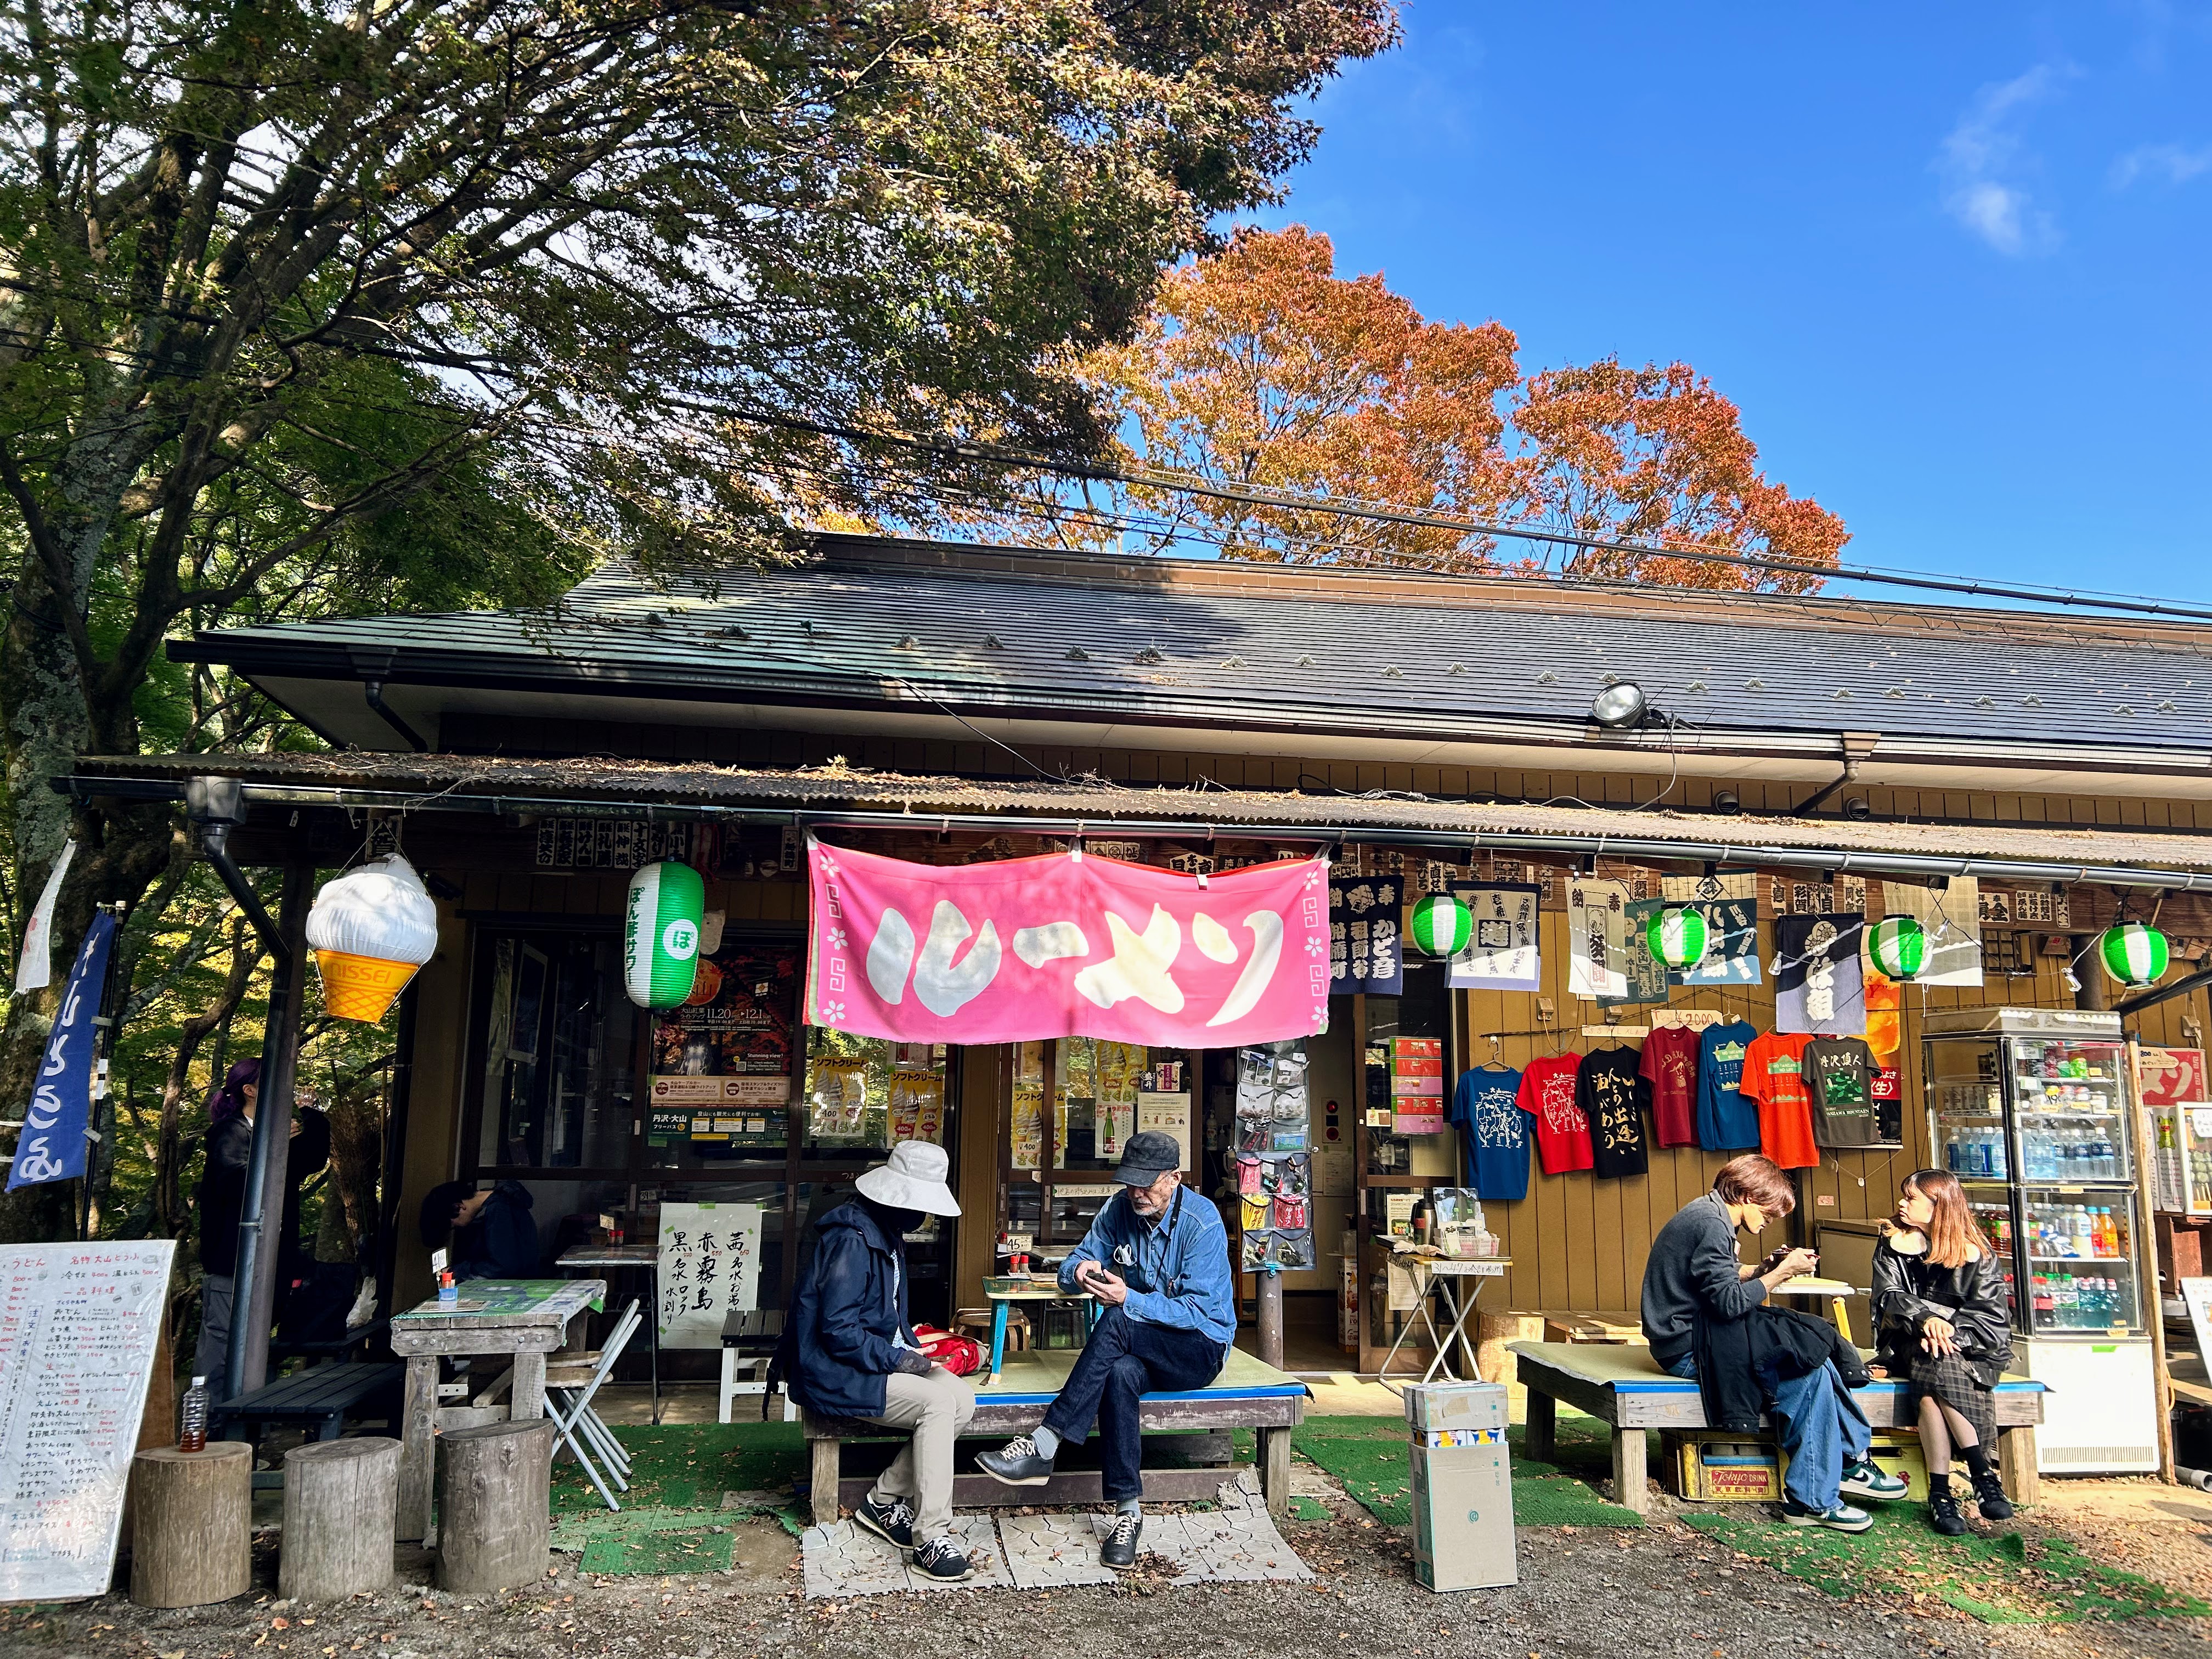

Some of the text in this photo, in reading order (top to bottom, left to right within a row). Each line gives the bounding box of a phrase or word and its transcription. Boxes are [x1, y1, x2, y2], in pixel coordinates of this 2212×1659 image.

[1329, 887, 1343, 907] 納
[1378, 884, 1395, 906] 奉
[1572, 888, 1584, 909] 納
[1609, 892, 1621, 913] 奉
[1795, 885, 1808, 912] 彩賀
[626, 887, 645, 985] ぽん酢サワー
[673, 930, 695, 950] ぽ
[1330, 922, 1348, 980] 船橋町
[1373, 919, 1396, 979] かど彦
[331, 963, 392, 984] NISSEI
[707, 1008, 731, 1019] 11.20
[1677, 1012, 1714, 1028] ¥2000
[816, 1059, 867, 1068] ソフトクリーム
[1820, 1052, 1862, 1068] 丹沢頂人
[893, 1073, 941, 1082] ソフトクリーム
[1015, 1093, 1064, 1102] ソフトクーム
[653, 1114, 687, 1123] 丹沢・大山
[669, 1232, 692, 1252] 黒
[726, 1232, 744, 1251] 茜
[1007, 1239, 1020, 1250] 45
[12, 1257, 46, 1269] うどん
[672, 1257, 688, 1281] 名水
[691, 1232, 718, 1311] 赤霧島
[64, 1286, 115, 1295] 一品料理
[664, 1287, 678, 1325] 水割り
[678, 1286, 689, 1317] ロック
[1713, 1470, 1767, 1485] Tokyo DRINK
